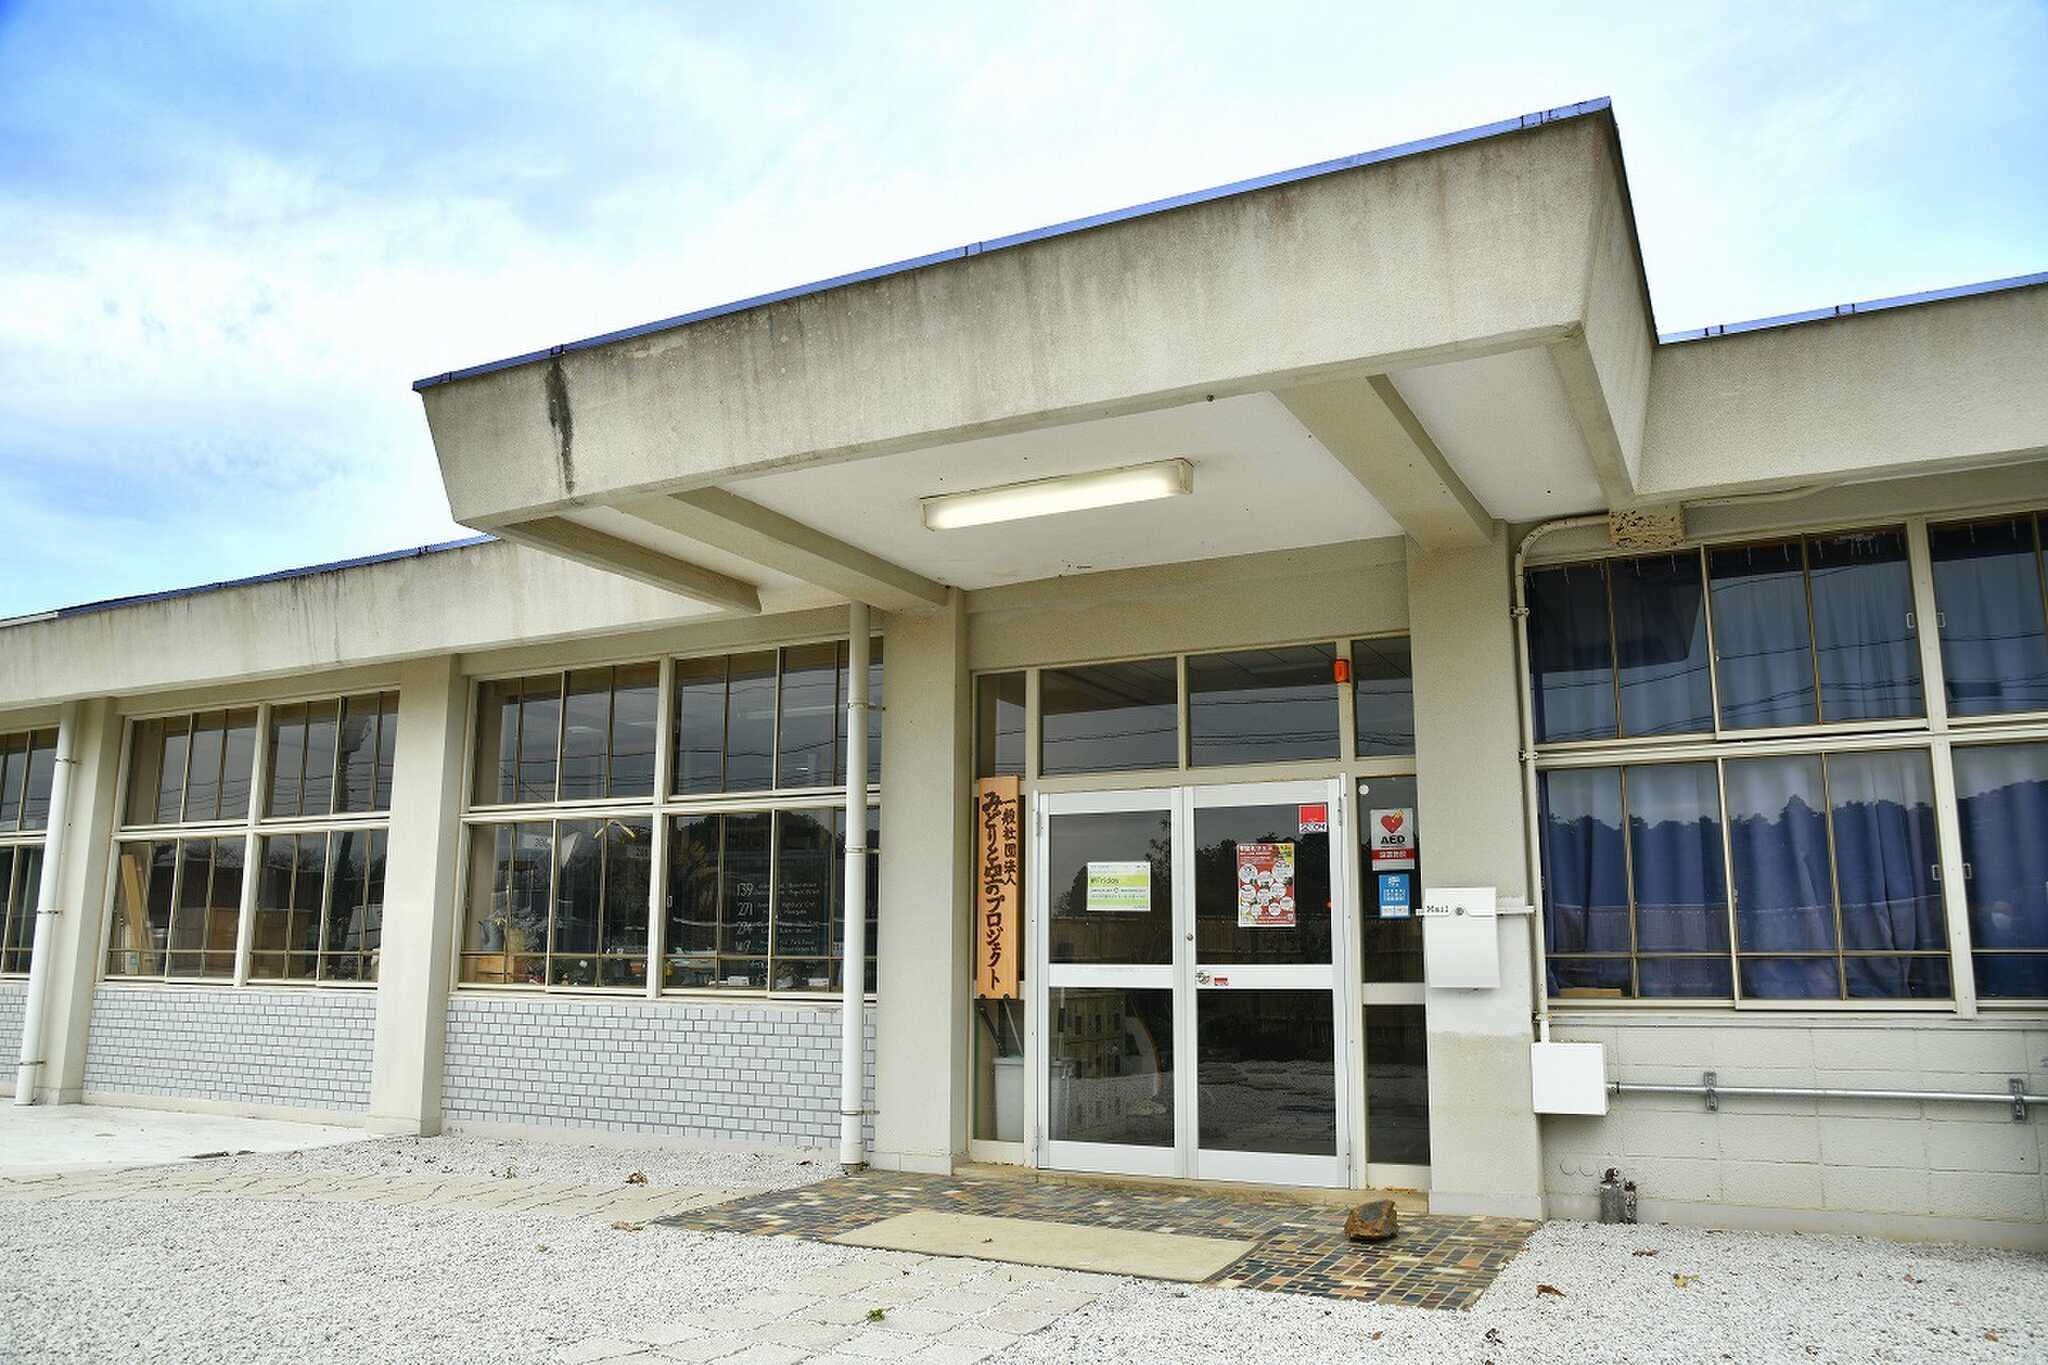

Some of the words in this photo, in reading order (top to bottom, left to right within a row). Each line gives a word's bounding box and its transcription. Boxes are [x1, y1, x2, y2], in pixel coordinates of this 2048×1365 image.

[1001, 799, 1017, 886] 一般社団法人
[1380, 834, 1405, 845] AED
[982, 792, 1005, 991] みどりと空のプロジェクト
[1427, 905, 1449, 913] Mail
